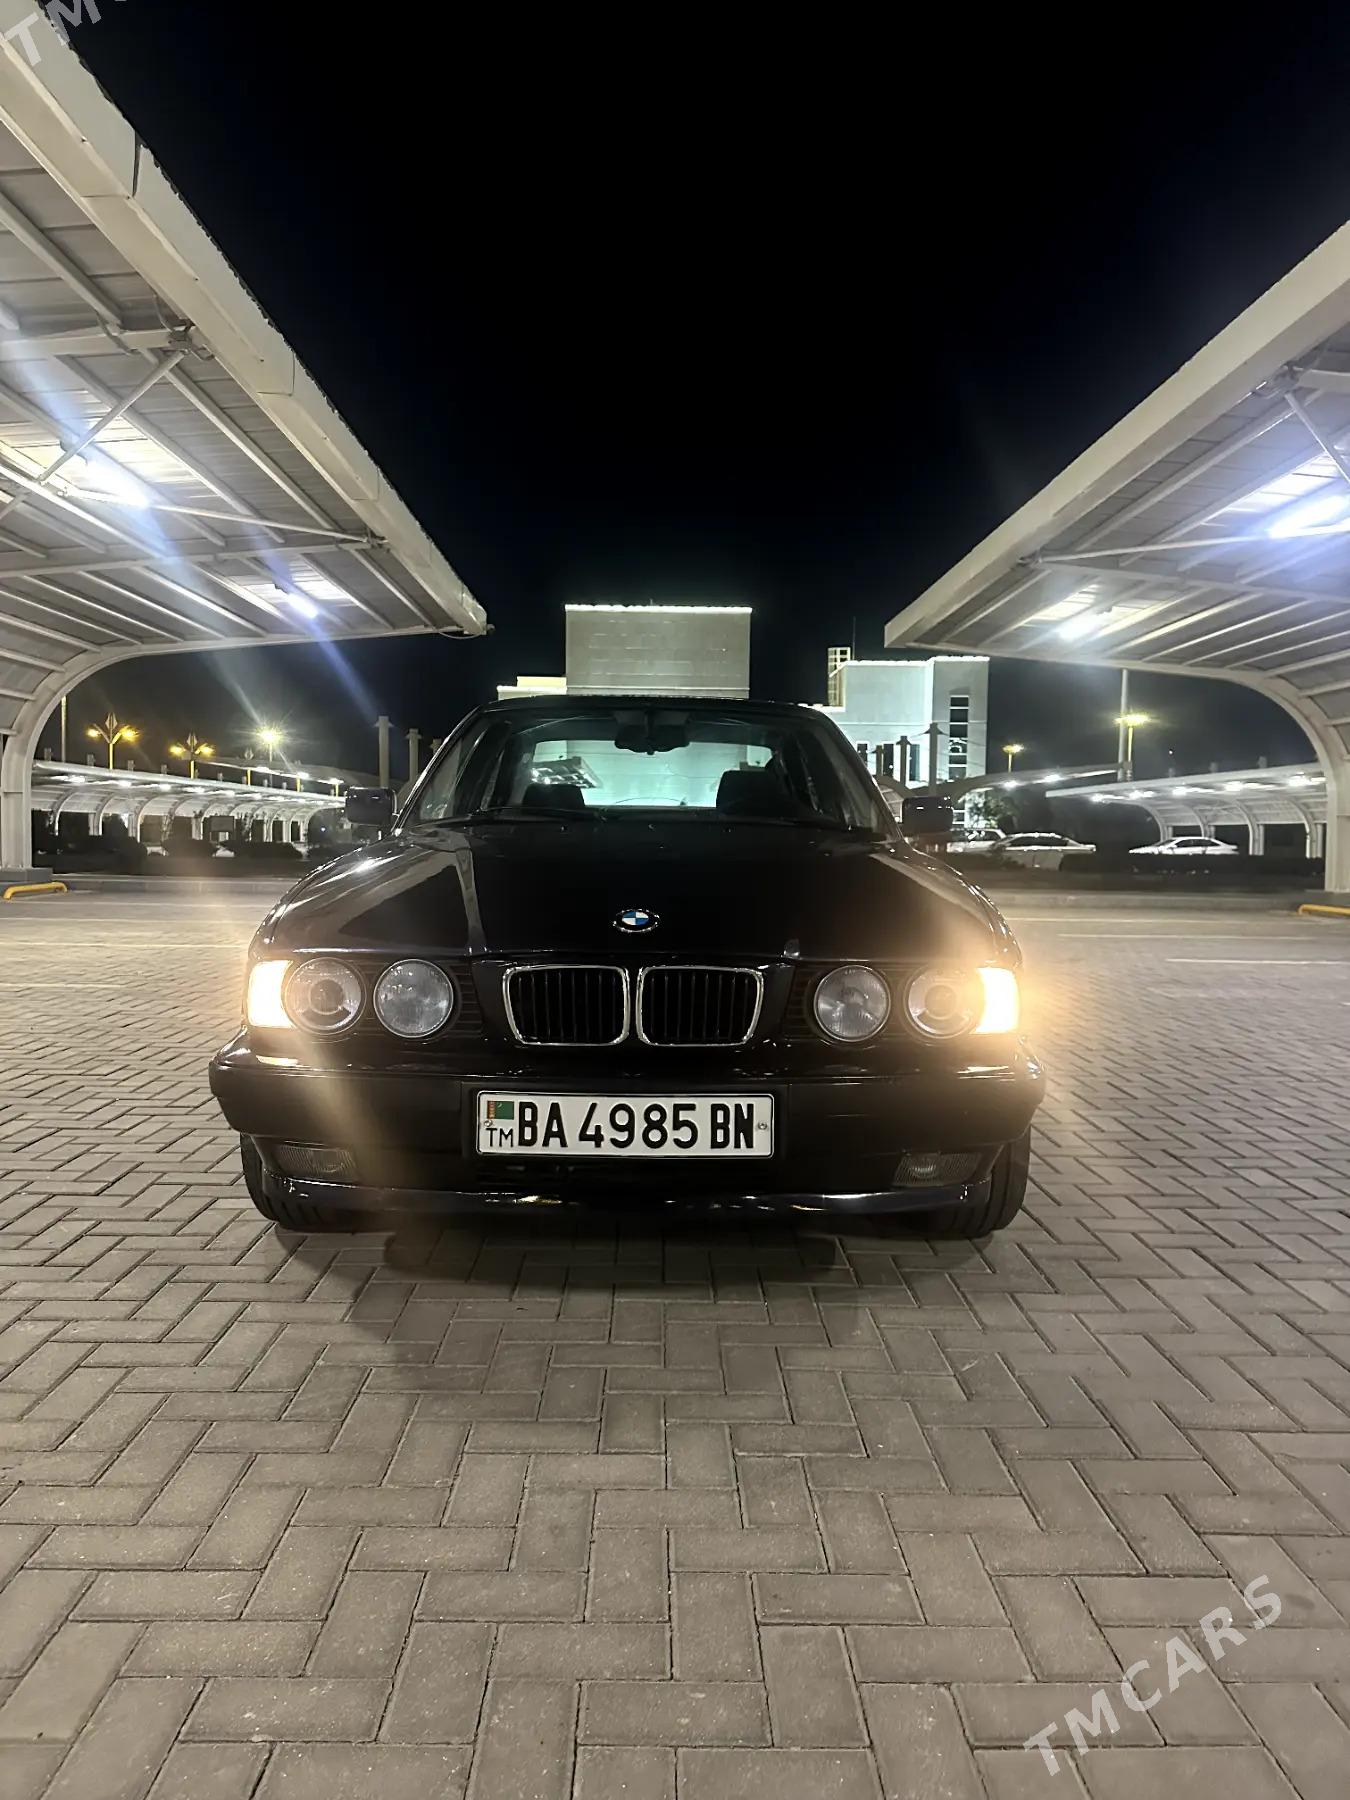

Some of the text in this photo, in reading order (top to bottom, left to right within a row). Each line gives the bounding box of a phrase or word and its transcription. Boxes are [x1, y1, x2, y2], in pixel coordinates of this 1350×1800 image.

[485, 1127, 514, 1148] TM
[518, 1101, 754, 1149] BA 4985 BN
